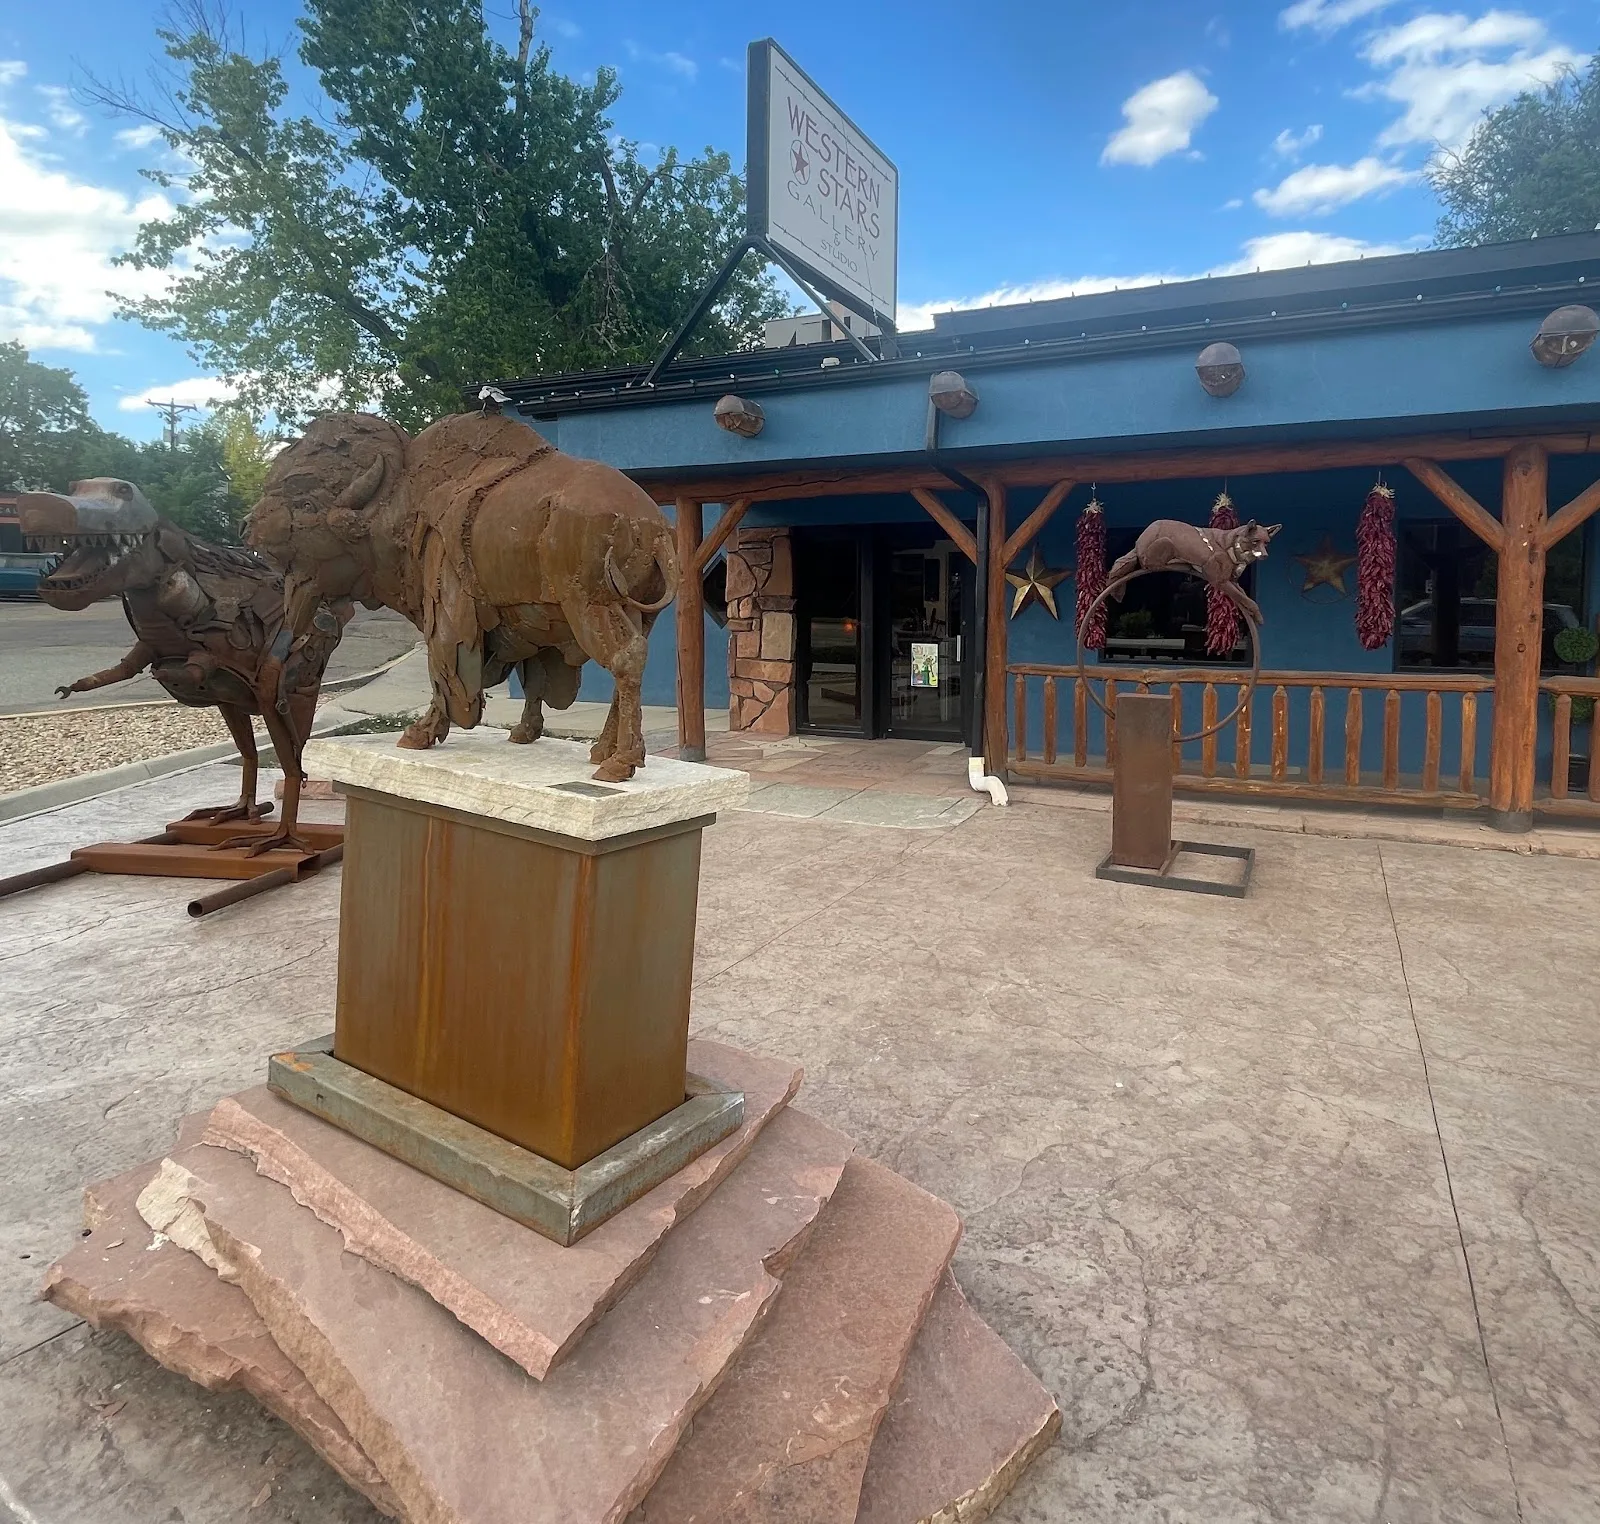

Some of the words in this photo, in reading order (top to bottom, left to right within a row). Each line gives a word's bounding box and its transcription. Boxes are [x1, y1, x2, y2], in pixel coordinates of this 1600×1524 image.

[787, 96, 880, 208] WESTERN
[787, 180, 878, 261] GALLERY
[817, 168, 880, 239] STARS
[820, 239, 858, 272] STUDIO
[833, 233, 841, 247] &
